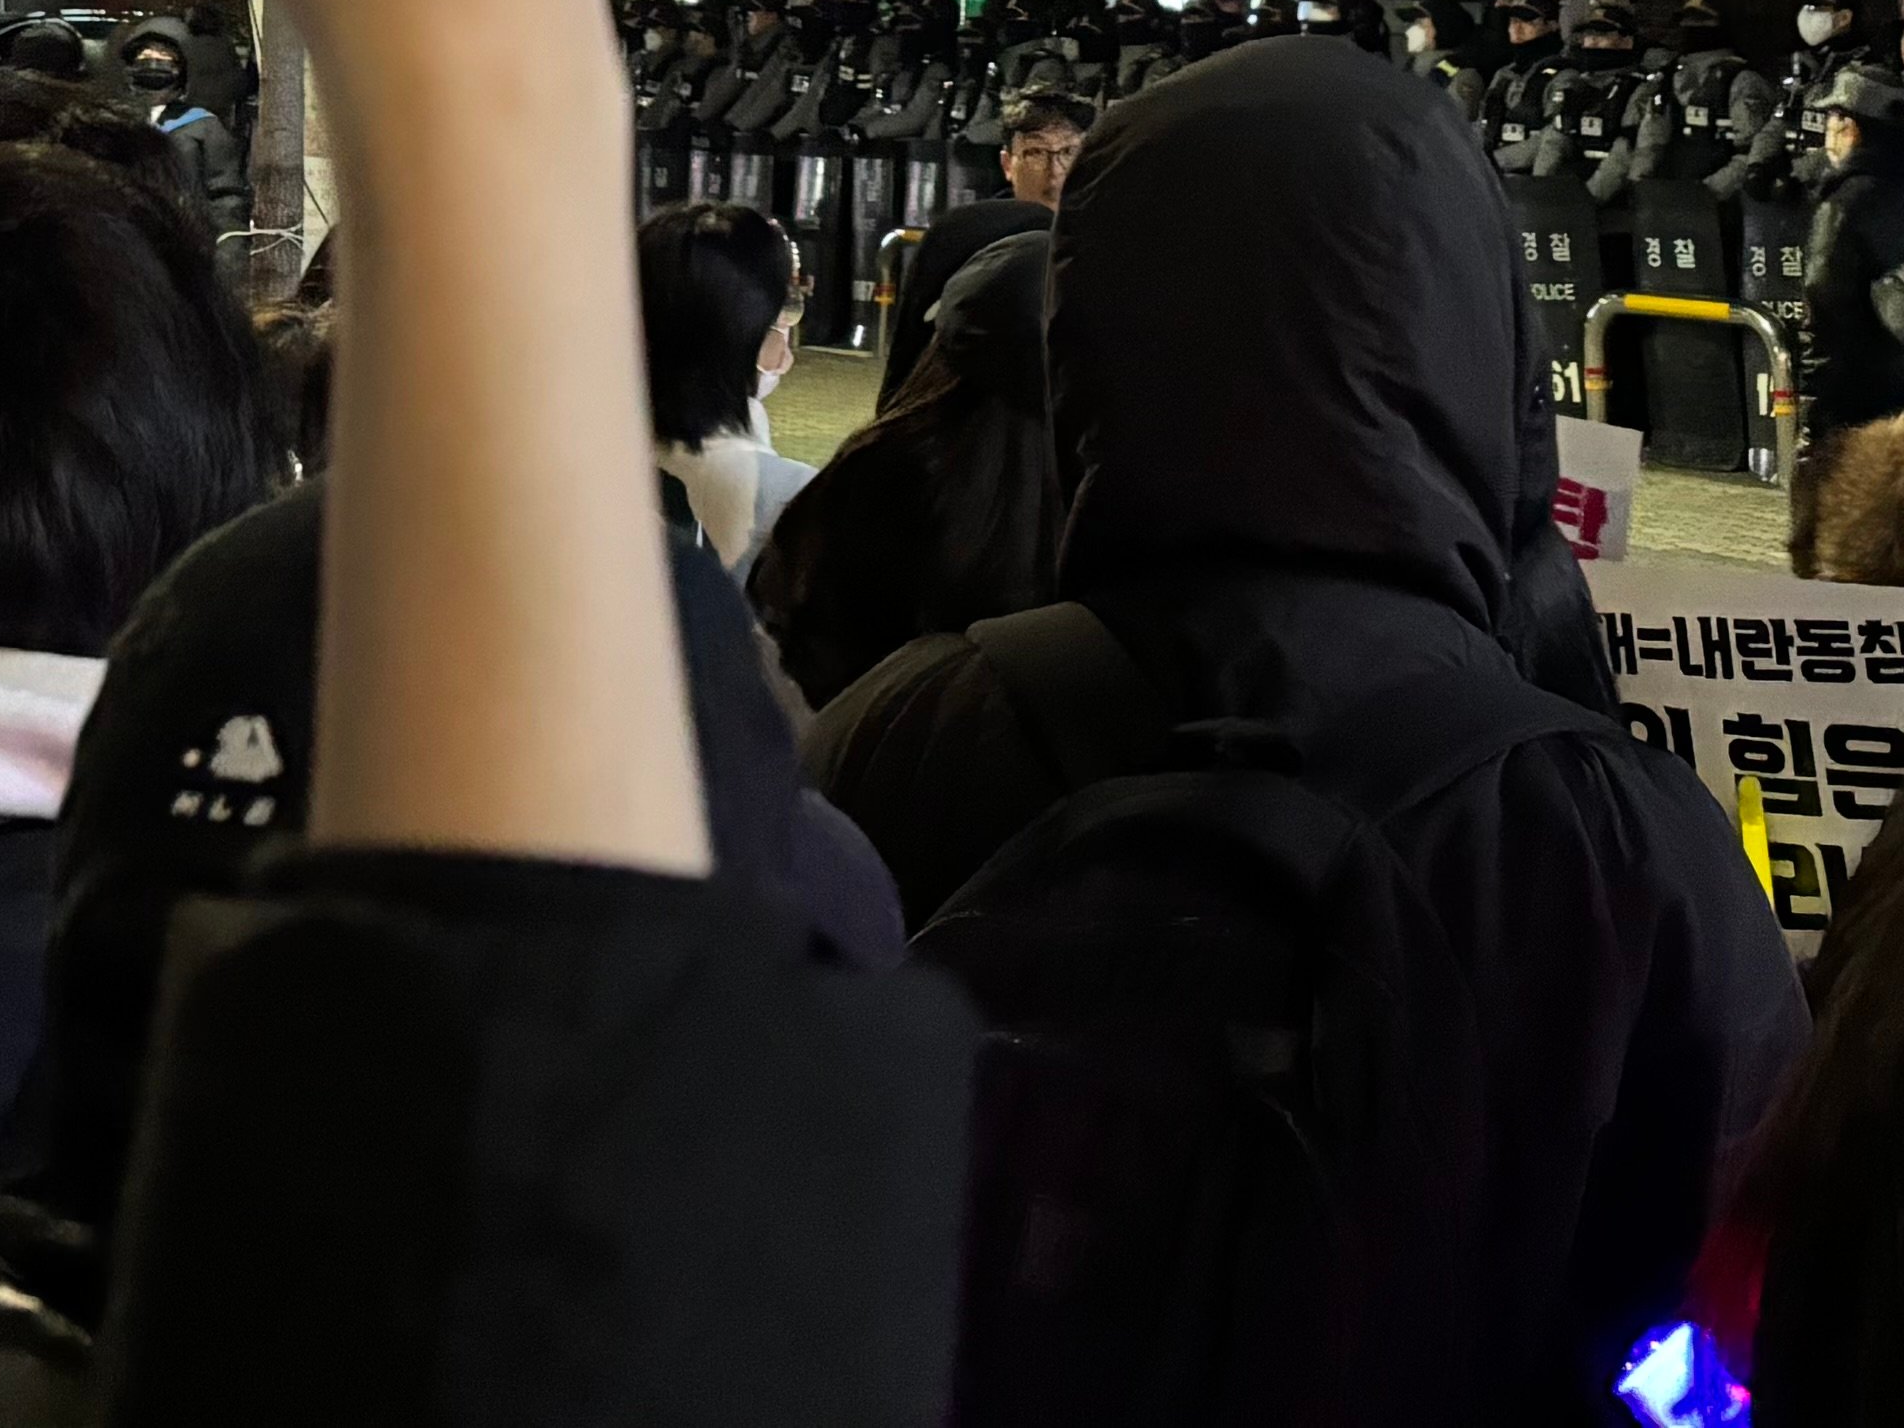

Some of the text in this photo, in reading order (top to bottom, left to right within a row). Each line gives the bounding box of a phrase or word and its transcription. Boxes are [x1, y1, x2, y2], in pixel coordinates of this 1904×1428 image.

[1522, 232, 1571, 262] 경찰
[1646, 237, 1696, 269] 경찰
[1750, 245, 1804, 277] 경찰
